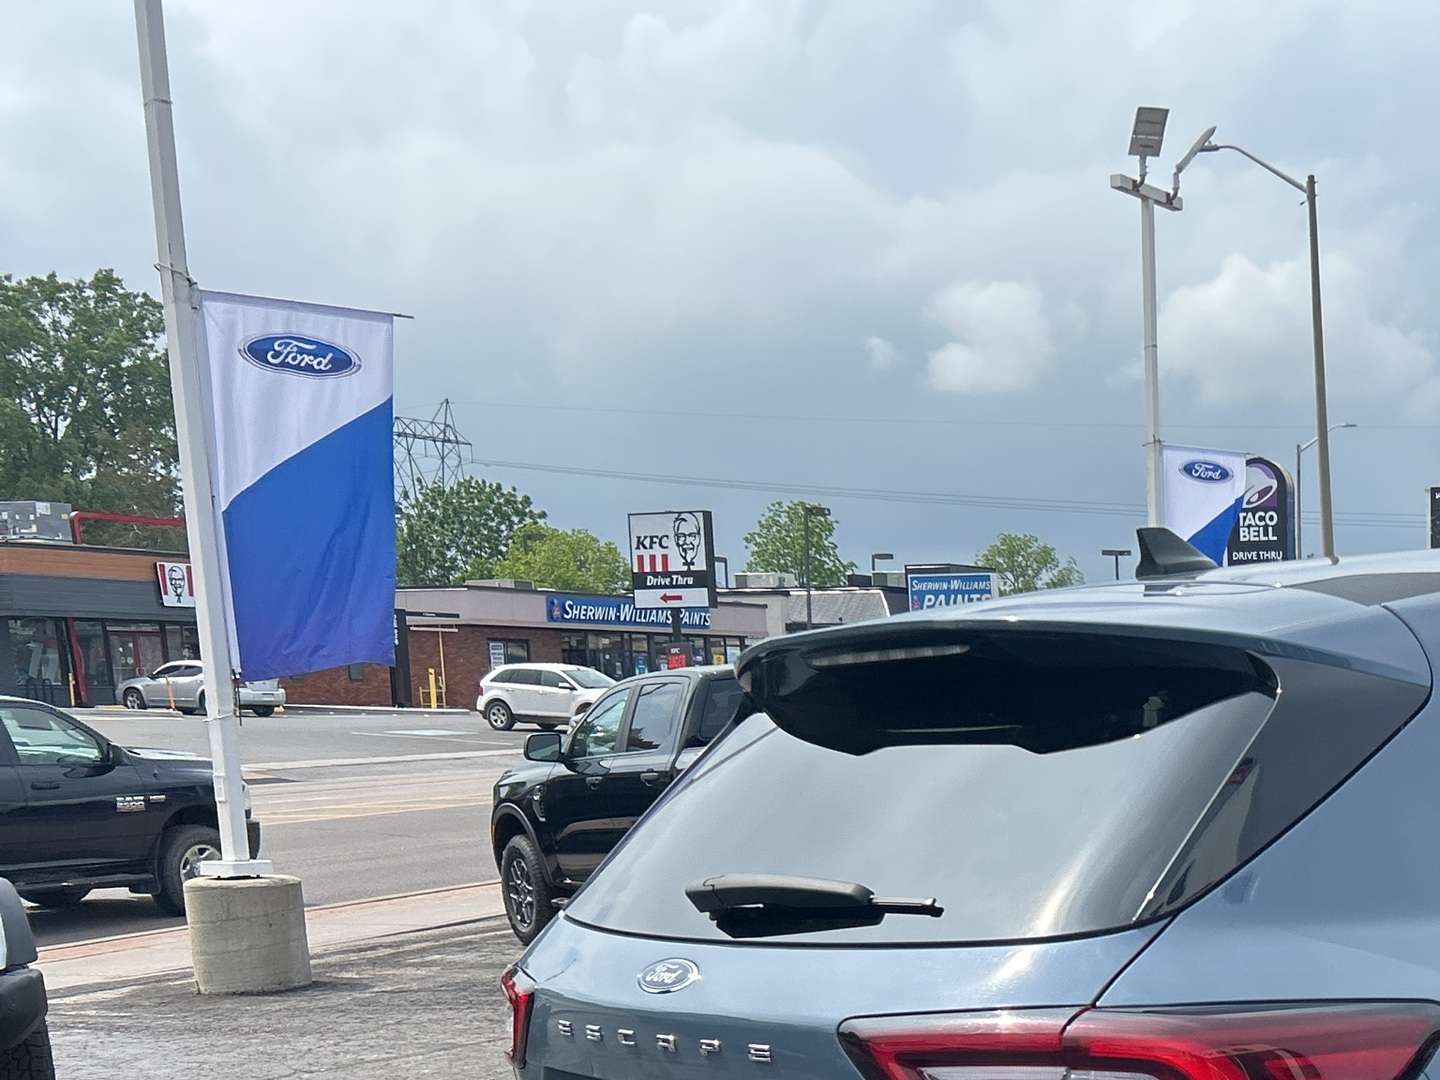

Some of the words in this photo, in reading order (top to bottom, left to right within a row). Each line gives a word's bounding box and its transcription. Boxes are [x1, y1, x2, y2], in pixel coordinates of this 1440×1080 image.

[267, 339, 334, 370] Ford
[1191, 463, 1223, 481] Ford
[1239, 511, 1278, 526] TACO
[635, 534, 670, 550] KFC
[1239, 527, 1278, 541] BELL
[1232, 551, 1257, 560] DRIVE
[1259, 550, 1283, 560] THRU
[646, 576, 671, 586] Drive
[672, 575, 694, 585] Thru
[563, 601, 672, 624] SHERWIN-WILLIAMS
[645, 963, 684, 985] Ford
[558, 1019, 773, 1063] ESCAPE
